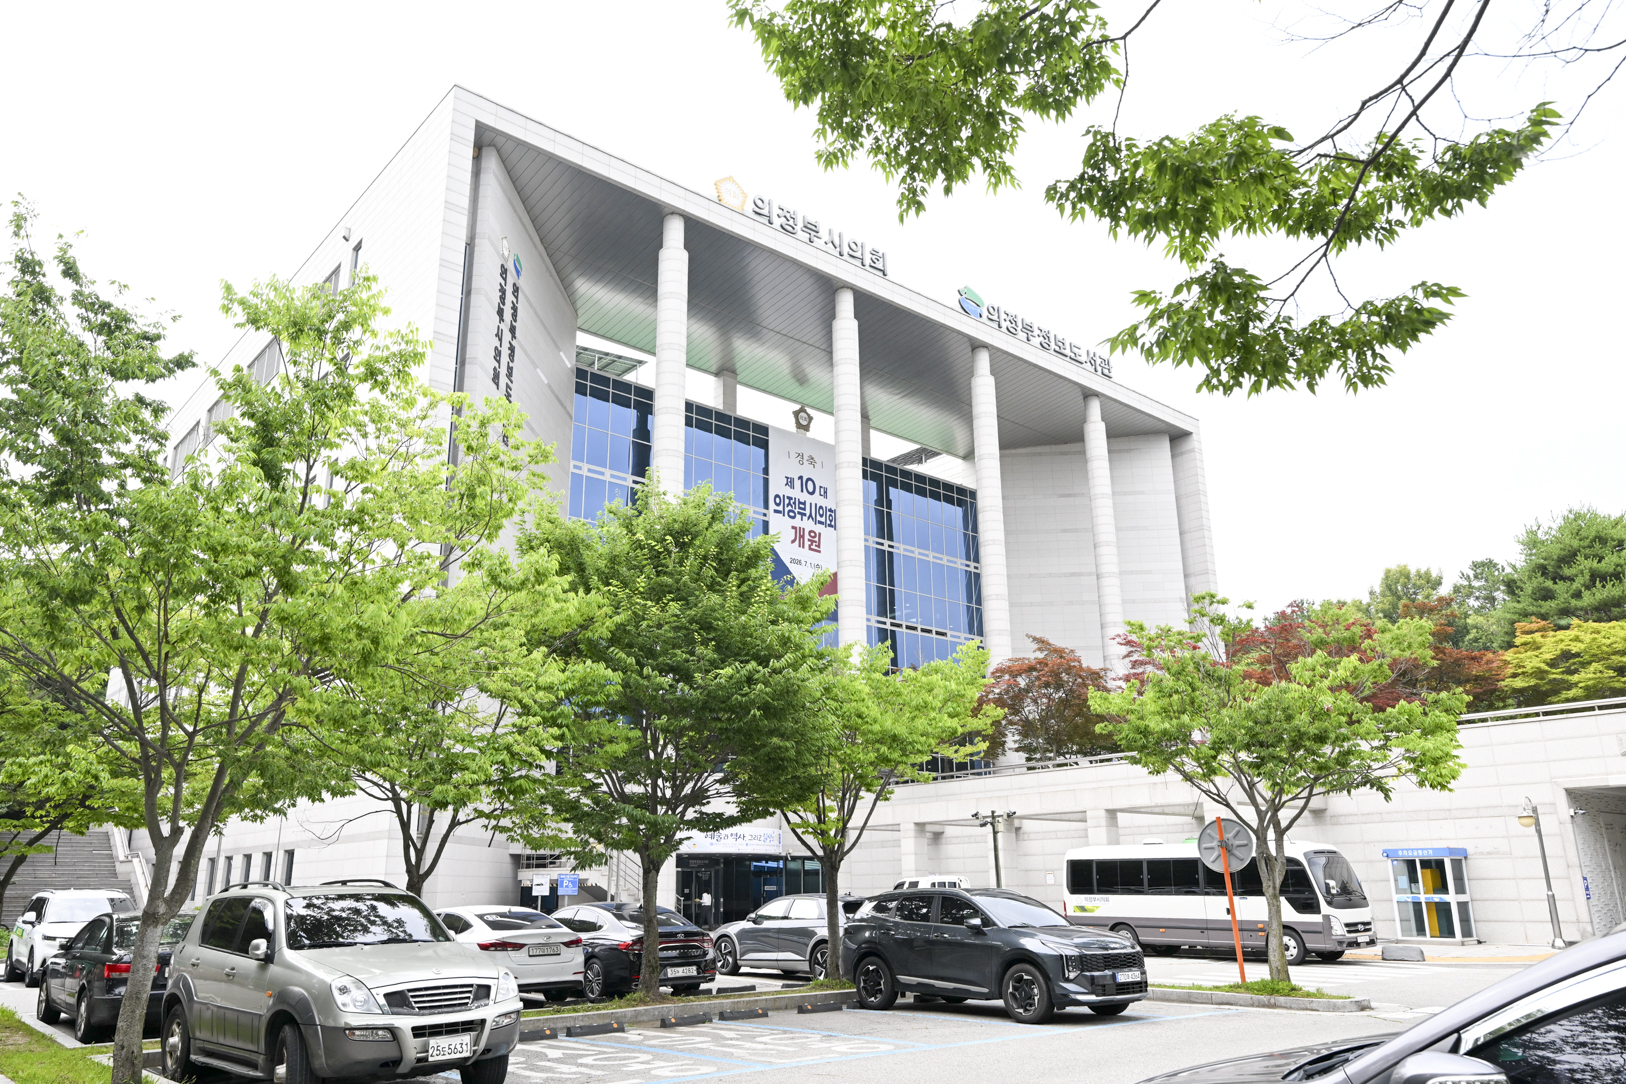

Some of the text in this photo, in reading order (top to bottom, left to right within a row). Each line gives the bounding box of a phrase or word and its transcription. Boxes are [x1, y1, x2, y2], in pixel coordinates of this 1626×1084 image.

[752, 194, 887, 277] 의정부시의회
[492, 263, 508, 391] 의정부시의회
[987, 304, 1113, 379] 의정부정보도서관
[502, 282, 519, 447] 의정부정보도
[795, 452, 817, 468] 경축
[773, 494, 837, 530] 의정부시의회
[791, 525, 822, 553] 개원
[430, 1042, 469, 1057] 25도5631
